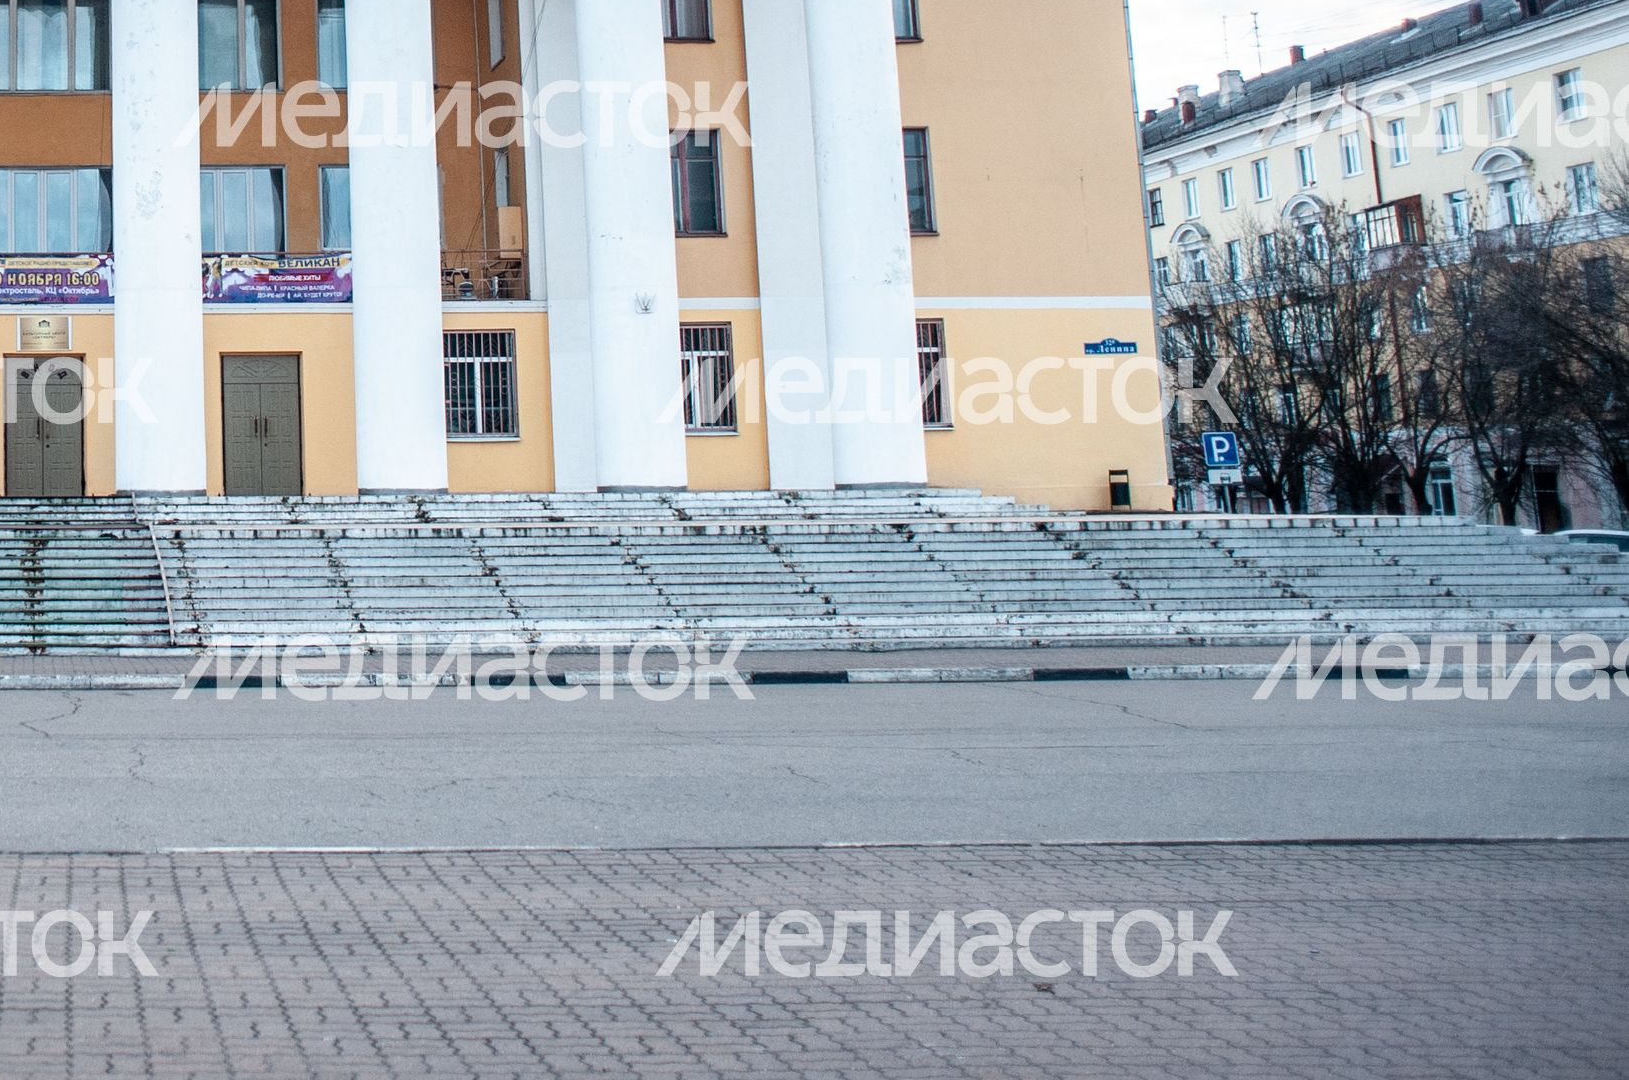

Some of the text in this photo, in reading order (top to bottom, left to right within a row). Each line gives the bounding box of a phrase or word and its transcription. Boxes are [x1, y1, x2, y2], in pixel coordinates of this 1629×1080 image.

[278, 258, 340, 268] ВЕЛИКАН
[7, 272, 62, 286] НОЯБРЯ
[66, 272, 101, 286] 16:00
[45, 287, 58, 296] КЦ
[1097, 344, 1135, 353] Ленина
[1211, 436, 1230, 463] P
